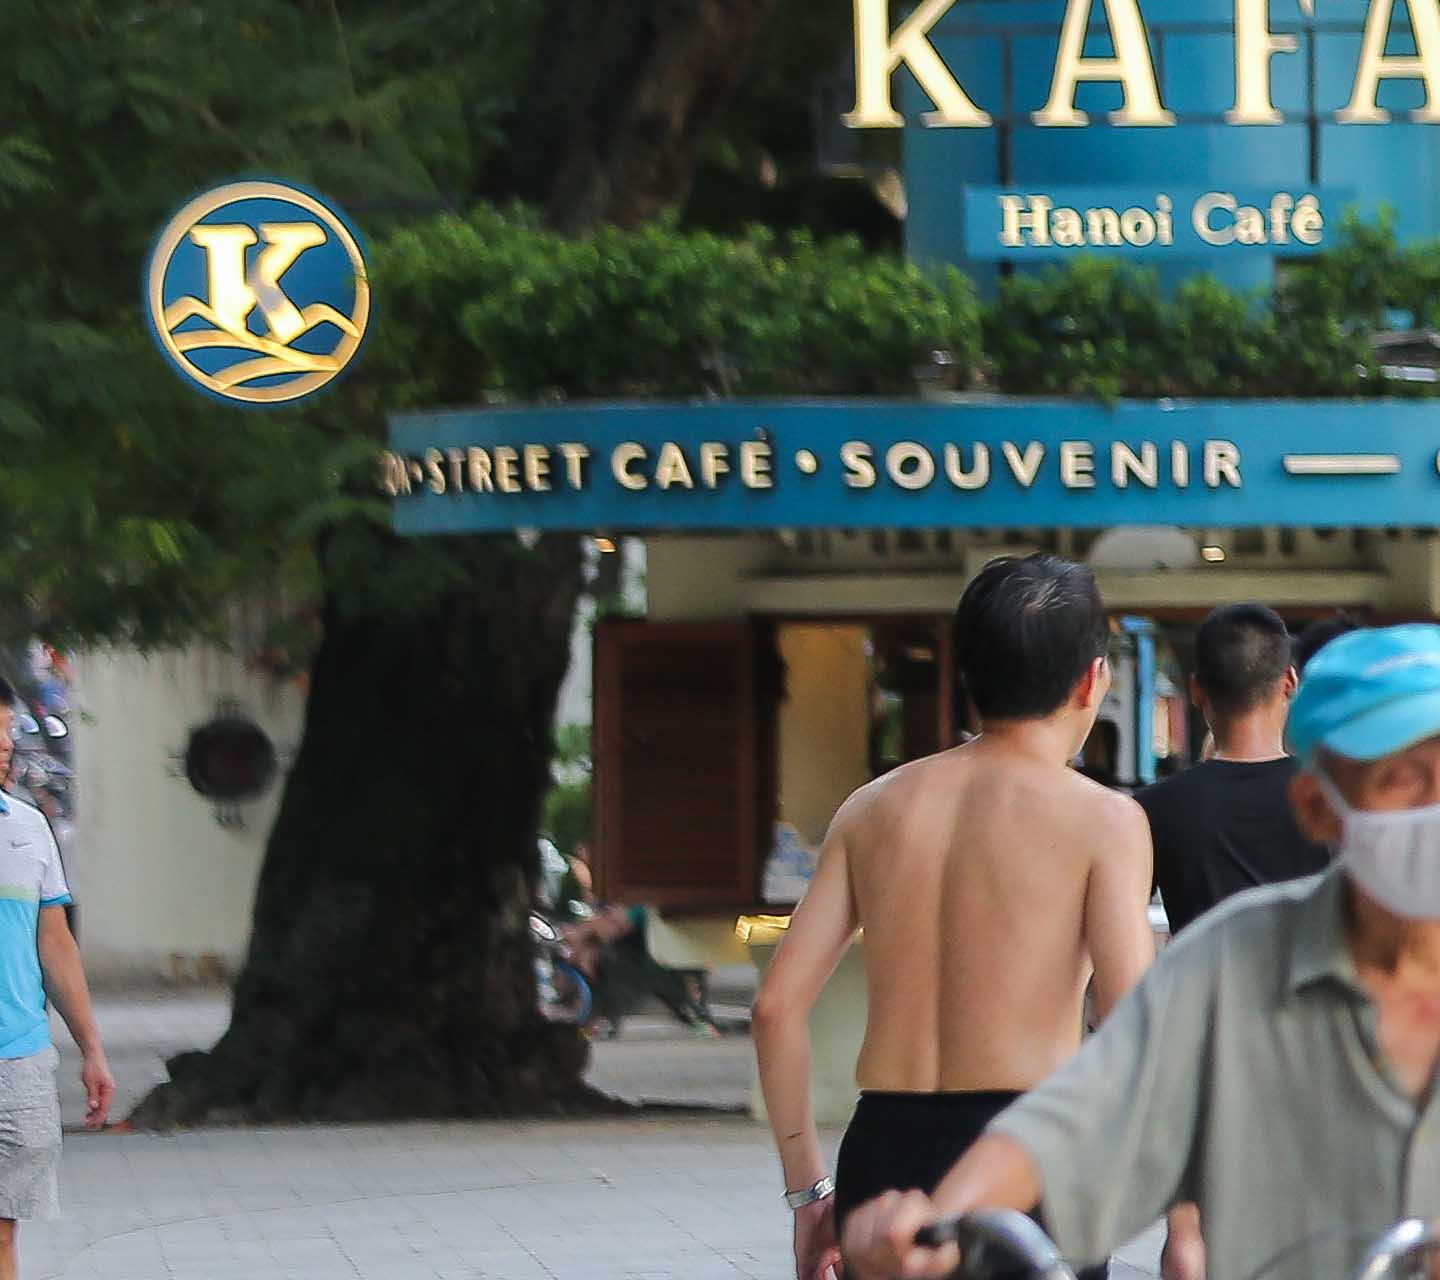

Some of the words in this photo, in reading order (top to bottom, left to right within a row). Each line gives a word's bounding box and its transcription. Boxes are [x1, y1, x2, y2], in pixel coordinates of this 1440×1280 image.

[1000, 193, 1174, 247] Hanoi
[1191, 191, 1325, 246] Café
[189, 221, 327, 345] K
[424, 441, 590, 496] STREET
[610, 426, 775, 491] CAFÉ
[839, 438, 1243, 490] SOUVENIR
